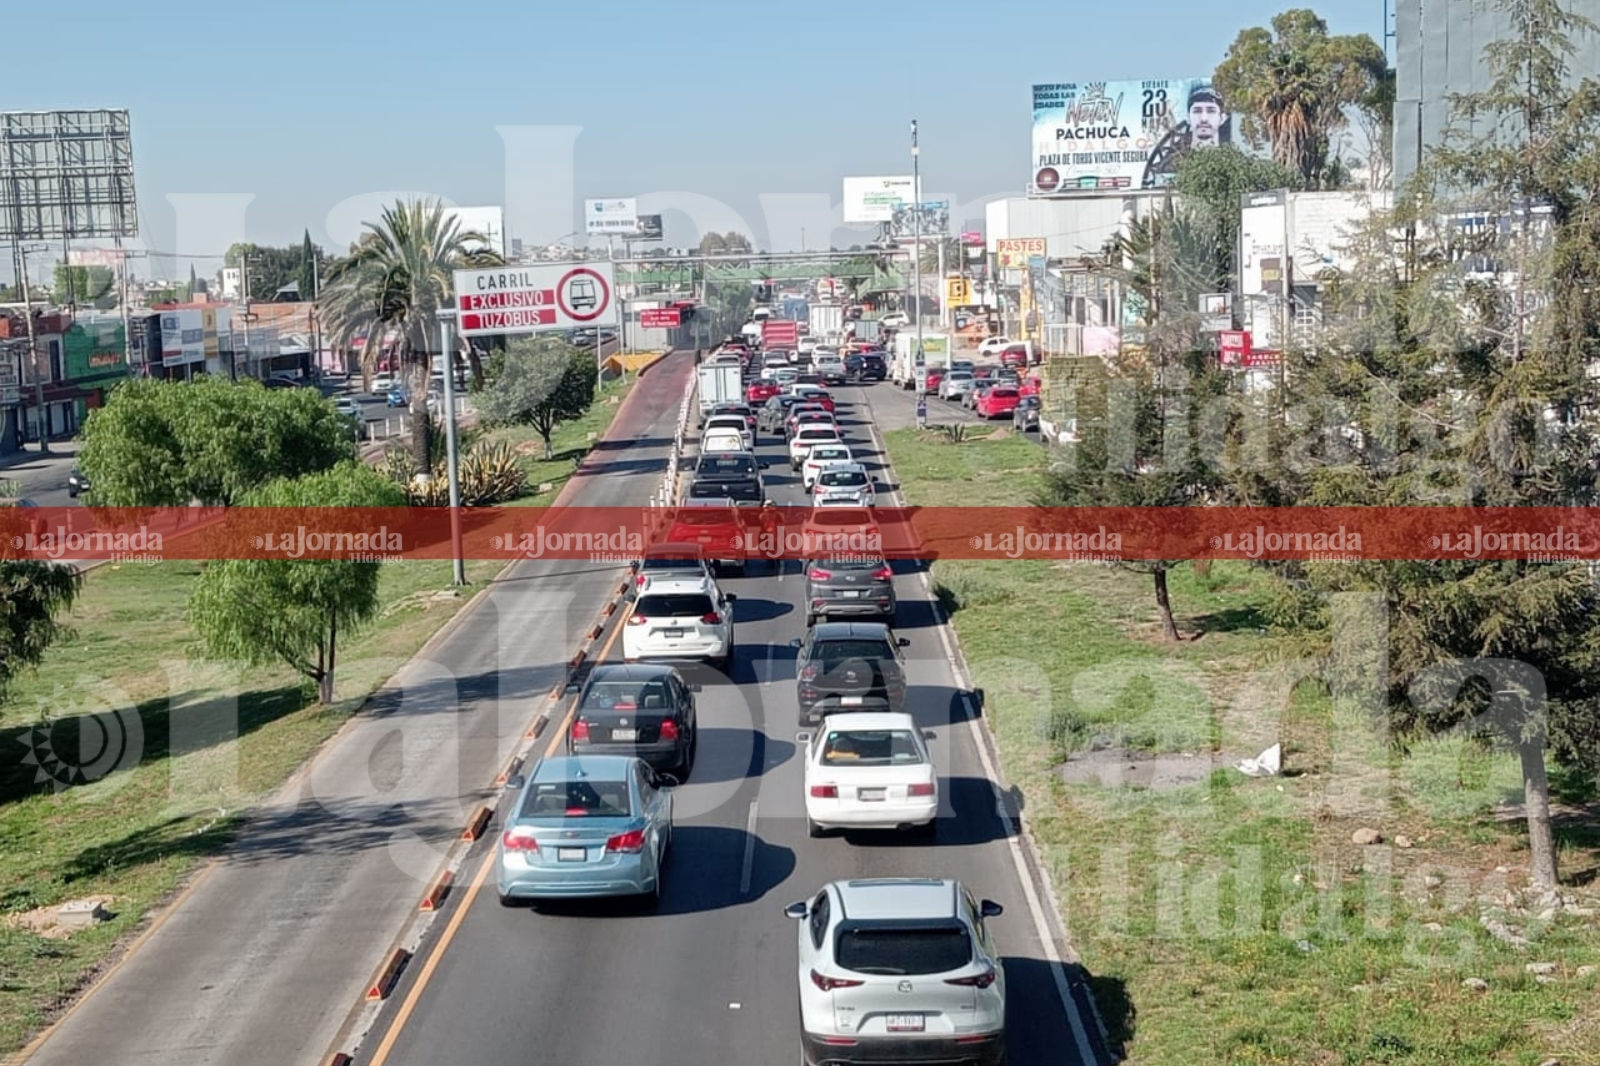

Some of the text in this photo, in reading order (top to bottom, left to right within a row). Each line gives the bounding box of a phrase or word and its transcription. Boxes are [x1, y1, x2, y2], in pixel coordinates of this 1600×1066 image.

[1142, 89, 1167, 117] 23
[1056, 126, 1130, 140] PACHUCA
[1039, 138, 1148, 154] HIDALGO
[1039, 150, 1149, 166] PLAZA DE TOROS VICENTE SEGURA
[999, 241, 1043, 252] PASTES
[477, 272, 534, 290] CARRIL
[470, 291, 544, 310] EXCLUSIVO
[478, 310, 541, 328] TUZOBUS
